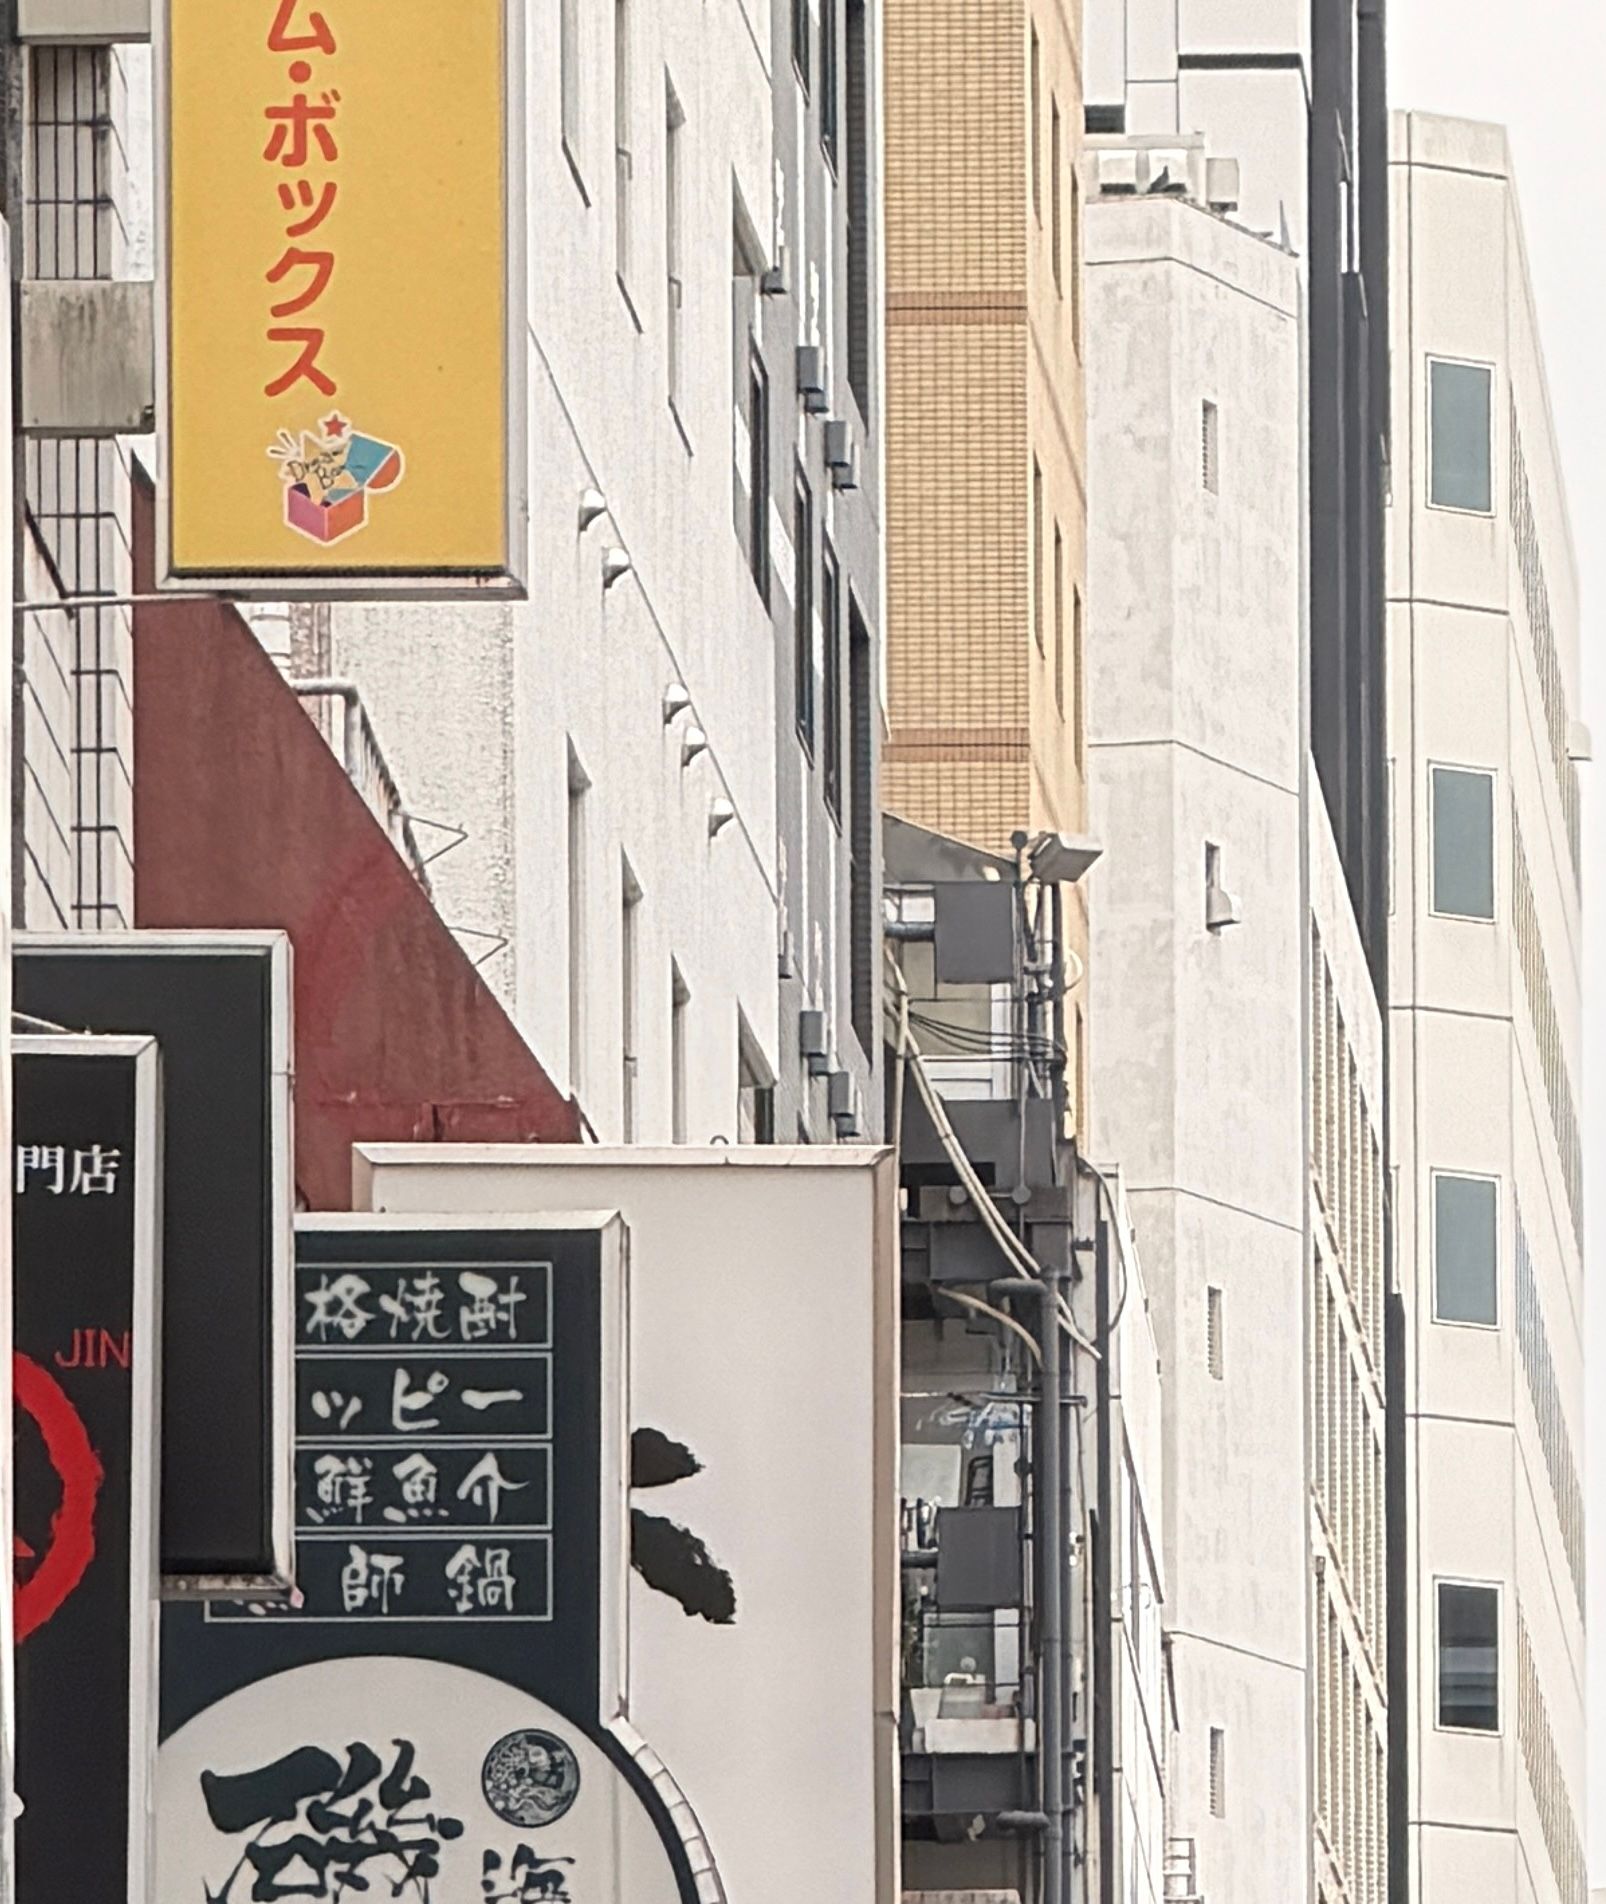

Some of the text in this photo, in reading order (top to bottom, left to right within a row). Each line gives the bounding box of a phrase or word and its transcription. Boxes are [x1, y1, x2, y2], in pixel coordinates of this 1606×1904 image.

[16, 1144, 121, 1195] 門店
[305, 1452, 529, 1525] 鮮魚介
